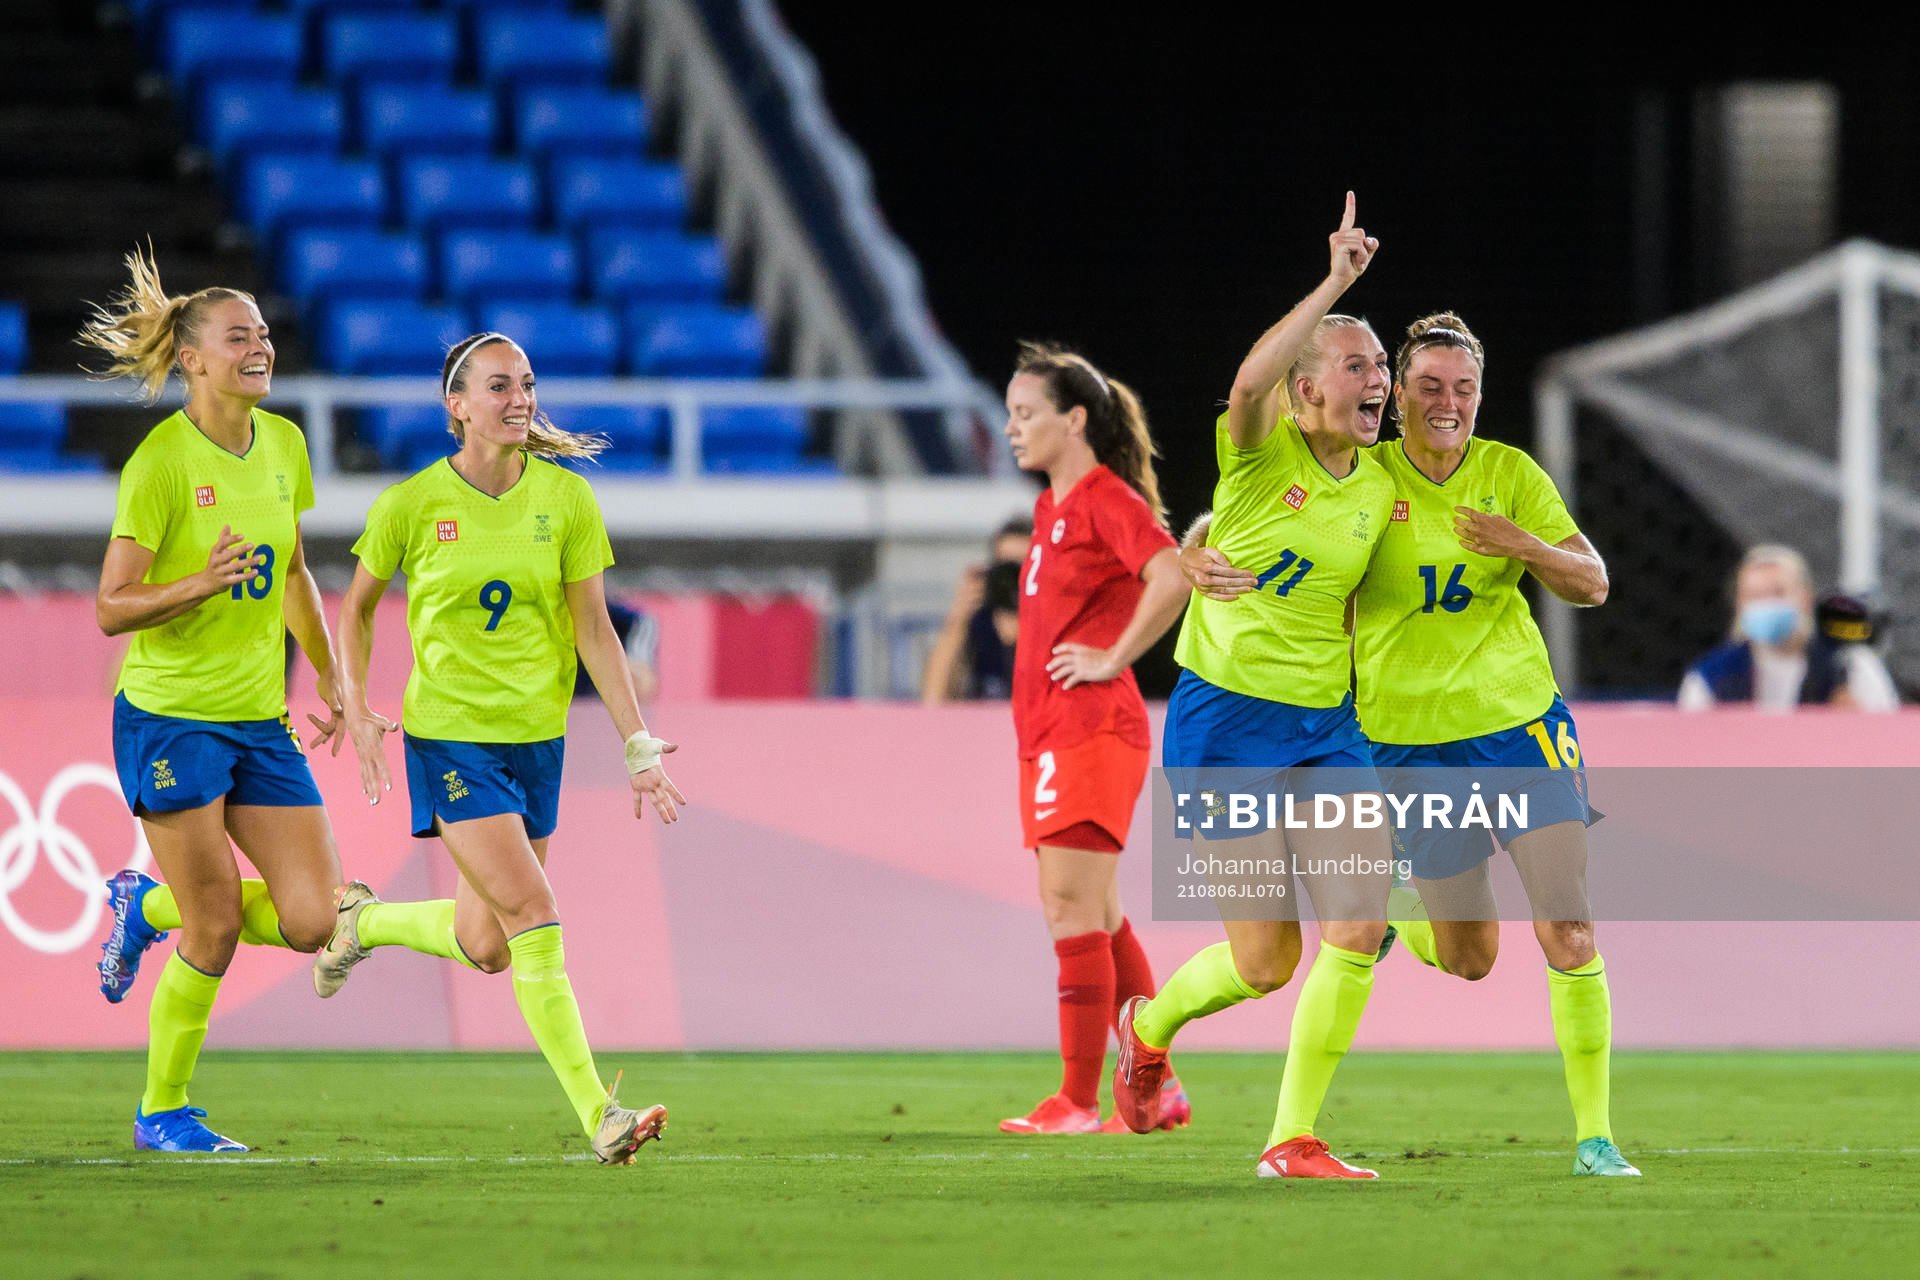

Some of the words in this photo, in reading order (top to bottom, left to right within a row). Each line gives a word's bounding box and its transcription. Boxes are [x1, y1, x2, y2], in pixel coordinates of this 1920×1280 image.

[197, 488, 211, 496] UNI
[1291, 486, 1305, 500] UNI
[198, 497, 214, 506] QLO
[1285, 493, 1301, 508] QLO
[438, 523, 454, 531] UNI
[439, 532, 456, 541] QLO
[1352, 529, 1367, 541] SWE
[231, 544, 275, 600] 18
[1025, 544, 1043, 596] 2
[1254, 549, 1314, 596] 11
[1418, 563, 1474, 613] 16
[479, 580, 512, 631] 9
[1525, 720, 1581, 771] 16
[154, 778, 177, 790] SWE
[1034, 751, 1058, 803] 2
[448, 787, 470, 802] SWE
[1206, 805, 1228, 817] SWE
